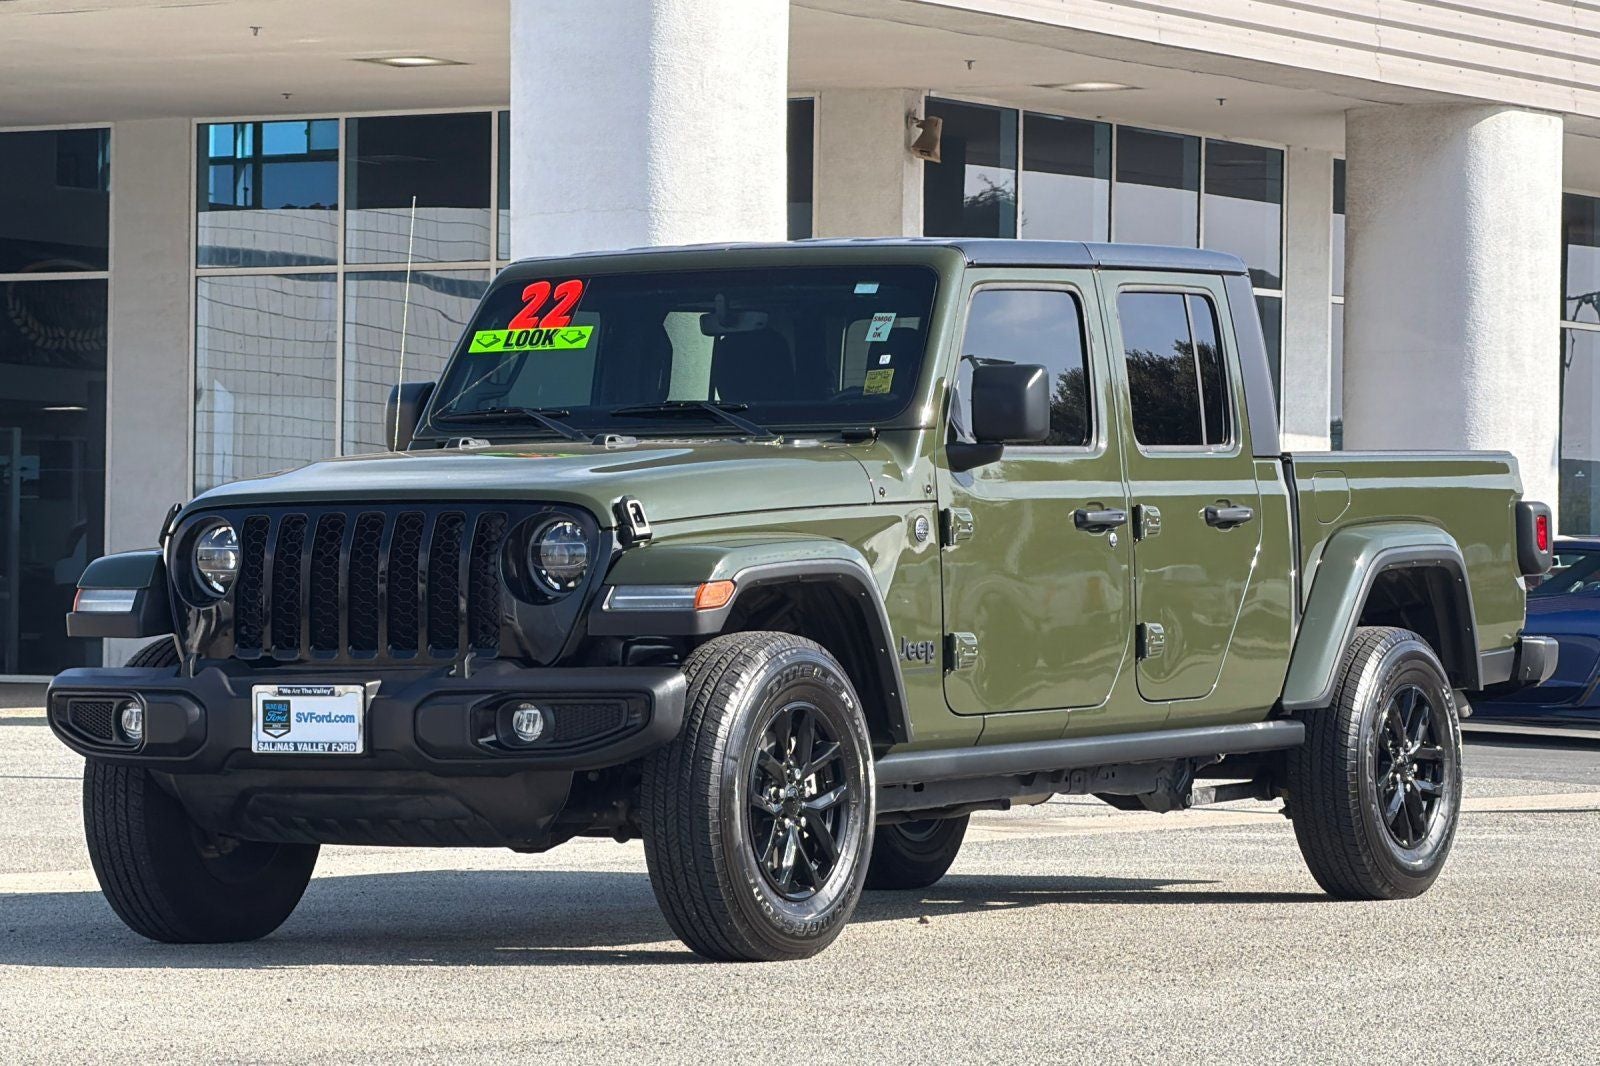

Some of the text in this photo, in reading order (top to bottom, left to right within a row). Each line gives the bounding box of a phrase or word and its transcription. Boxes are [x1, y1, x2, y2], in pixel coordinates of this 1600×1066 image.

[508, 279, 583, 330] 22
[503, 329, 560, 349] LOOK
[898, 636, 935, 665] Jeep
[265, 711, 288, 722] Ford
[296, 712, 355, 723] SVFord.com
[258, 742, 356, 751] SALINAS VALLEY FORD
